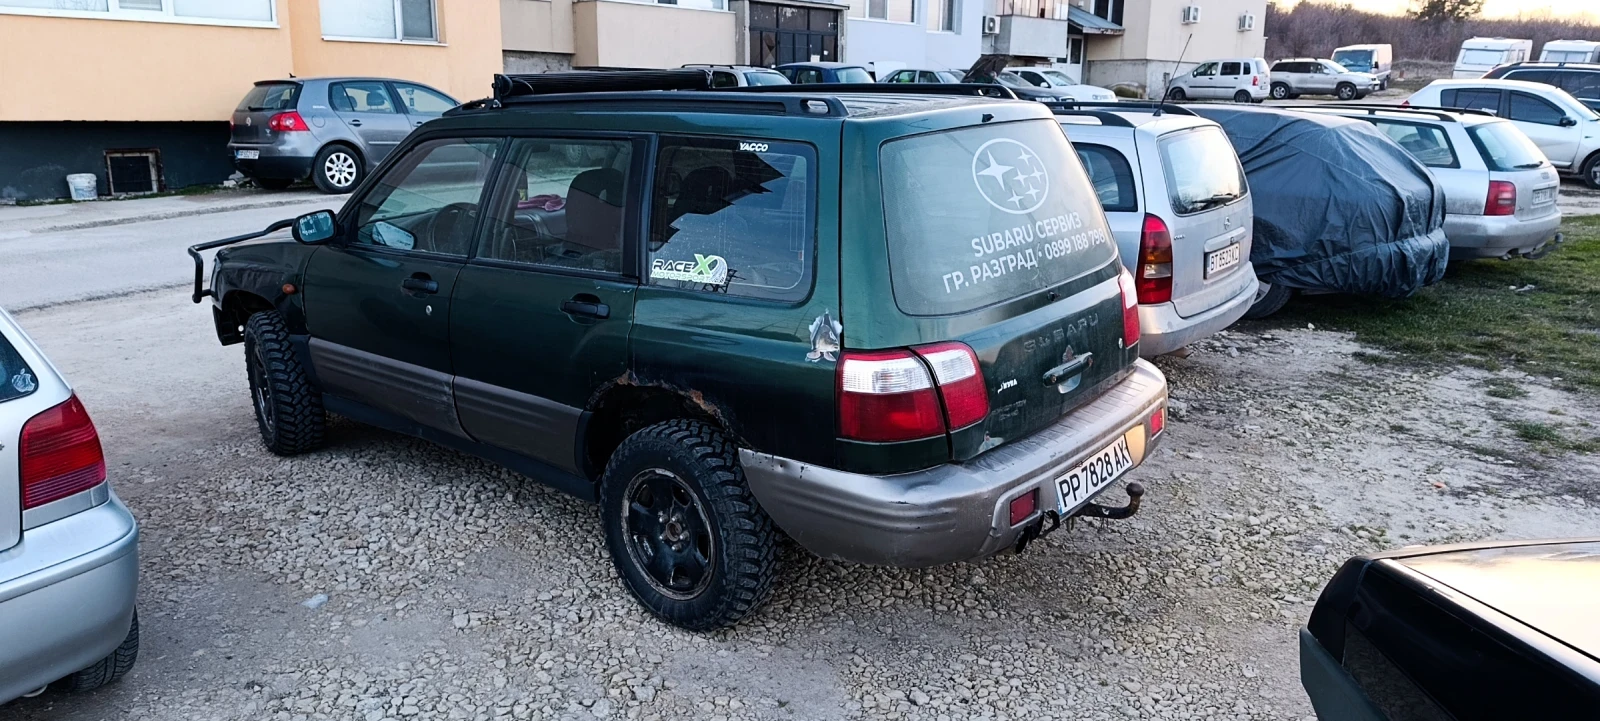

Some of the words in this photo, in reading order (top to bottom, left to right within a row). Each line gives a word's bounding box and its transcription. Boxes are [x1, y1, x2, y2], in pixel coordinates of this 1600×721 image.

[740, 143, 768, 152] YACCO
[972, 224, 1033, 257] SUBARU
[1036, 211, 1082, 238] СЕРВИЗ
[652, 271, 712, 282] MOTORSPORT
[942, 270, 969, 293] ГР.
[970, 248, 1038, 284] РАЗГРАД
[1044, 240, 1071, 260] 0899
[1072, 233, 1089, 251] 188
[1089, 228, 1106, 246] 798
[1058, 473, 1081, 508] PP
[1081, 452, 1114, 494] 7828
[1113, 440, 1130, 472] AX
